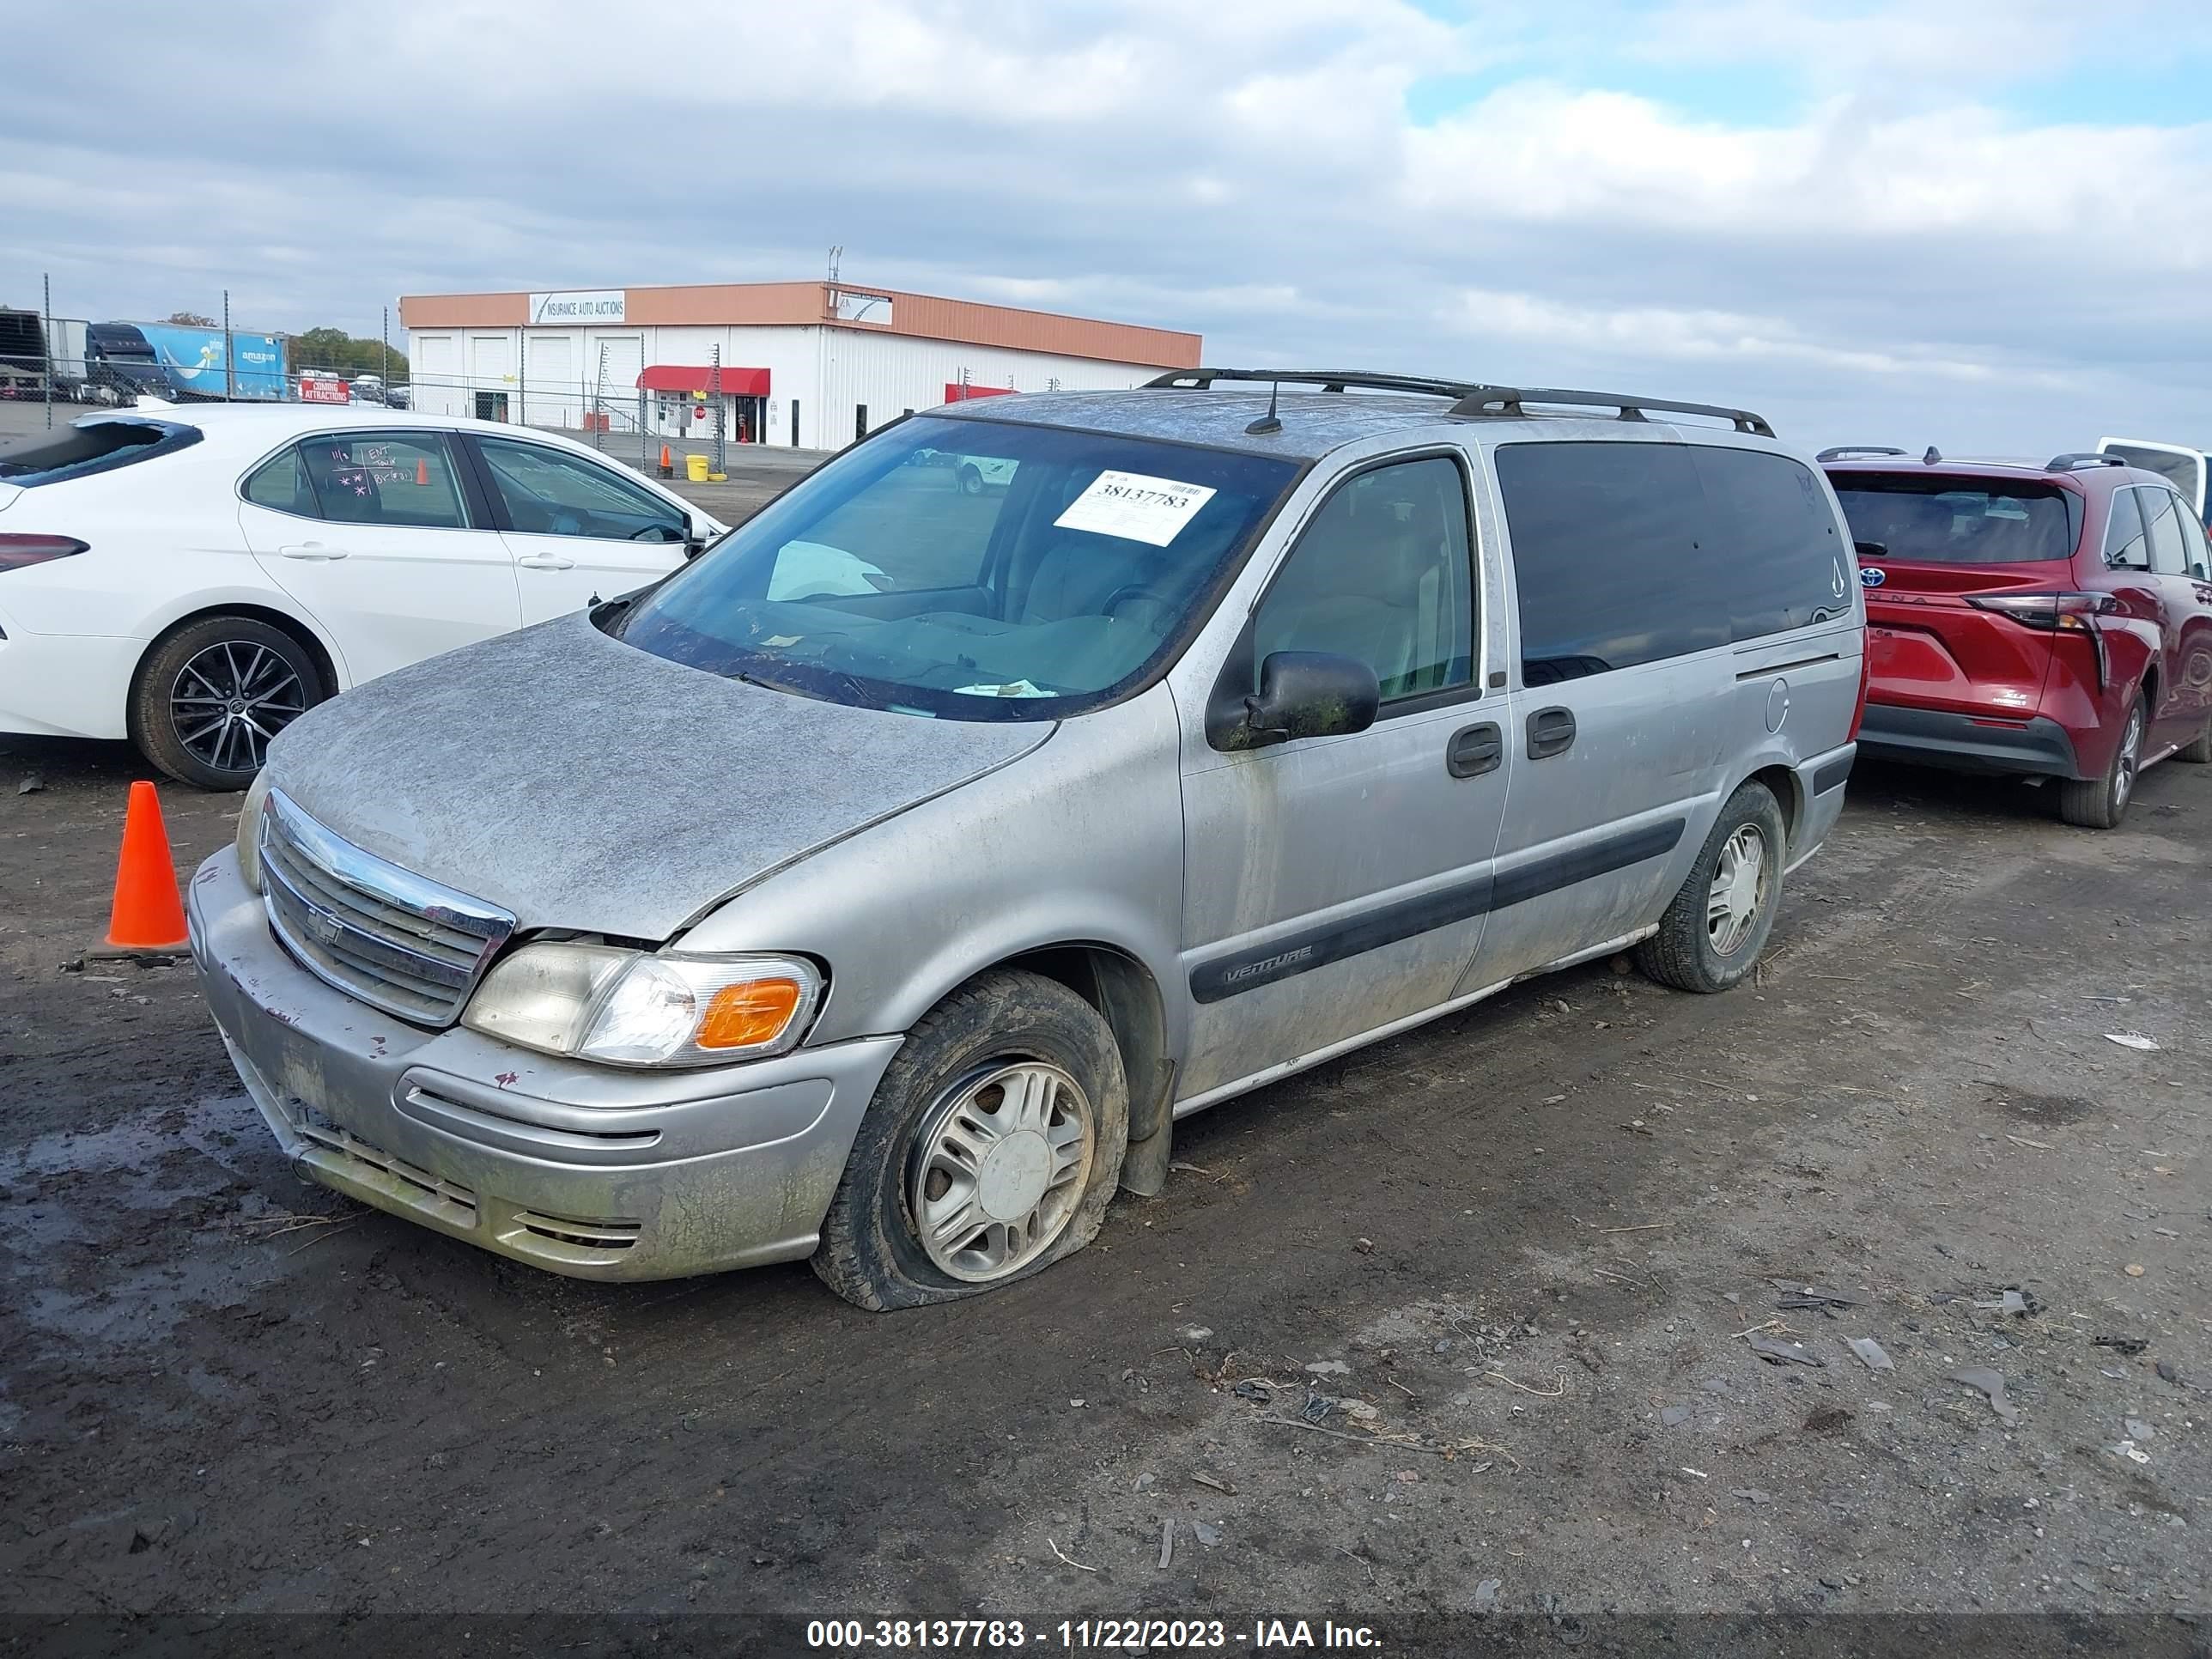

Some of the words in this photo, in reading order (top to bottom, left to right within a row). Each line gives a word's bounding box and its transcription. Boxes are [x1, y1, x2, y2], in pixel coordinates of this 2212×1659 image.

[547, 301, 576, 316] INSURANCE
[579, 301, 593, 315] AUTO
[595, 301, 623, 315] AUCTIONS
[242, 351, 276, 362] amazon
[313, 381, 338, 392] COMING
[305, 390, 348, 402] ATTRACTIONS
[368, 446, 390, 459] ENT
[1097, 483, 1189, 508] 38137783
[1868, 593, 1928, 604] NNA
[1224, 945, 1313, 982] VENTURE
